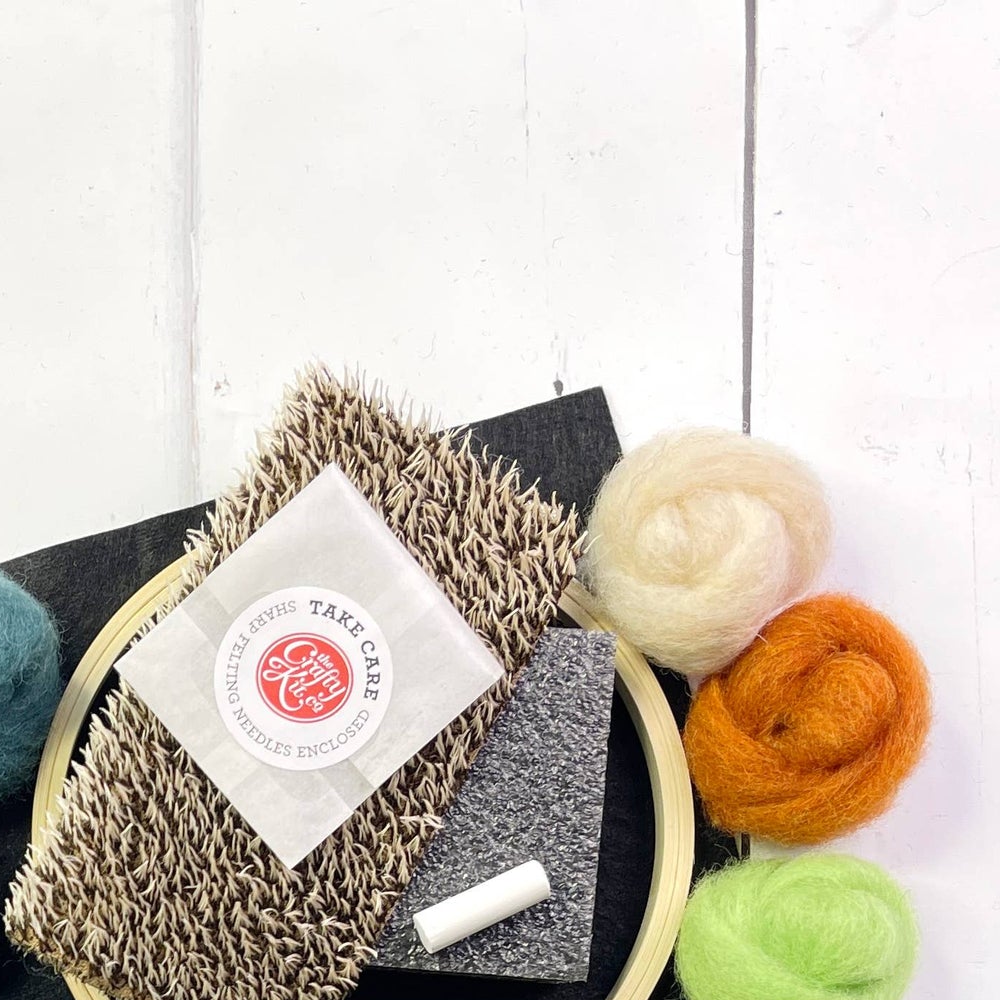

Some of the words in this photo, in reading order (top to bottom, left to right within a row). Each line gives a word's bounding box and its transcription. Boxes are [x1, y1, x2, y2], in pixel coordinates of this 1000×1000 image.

[249, 600, 296, 634] SHARP
[226, 633, 250, 704] FELTING
[284, 640, 346, 702] Crafty
[309, 600, 365, 638] TAKE
[361, 640, 381, 701] CARE
[263, 656, 309, 711] Kit
[233, 707, 292, 757] NEEDLES
[297, 709, 370, 758] ENCLOSED
